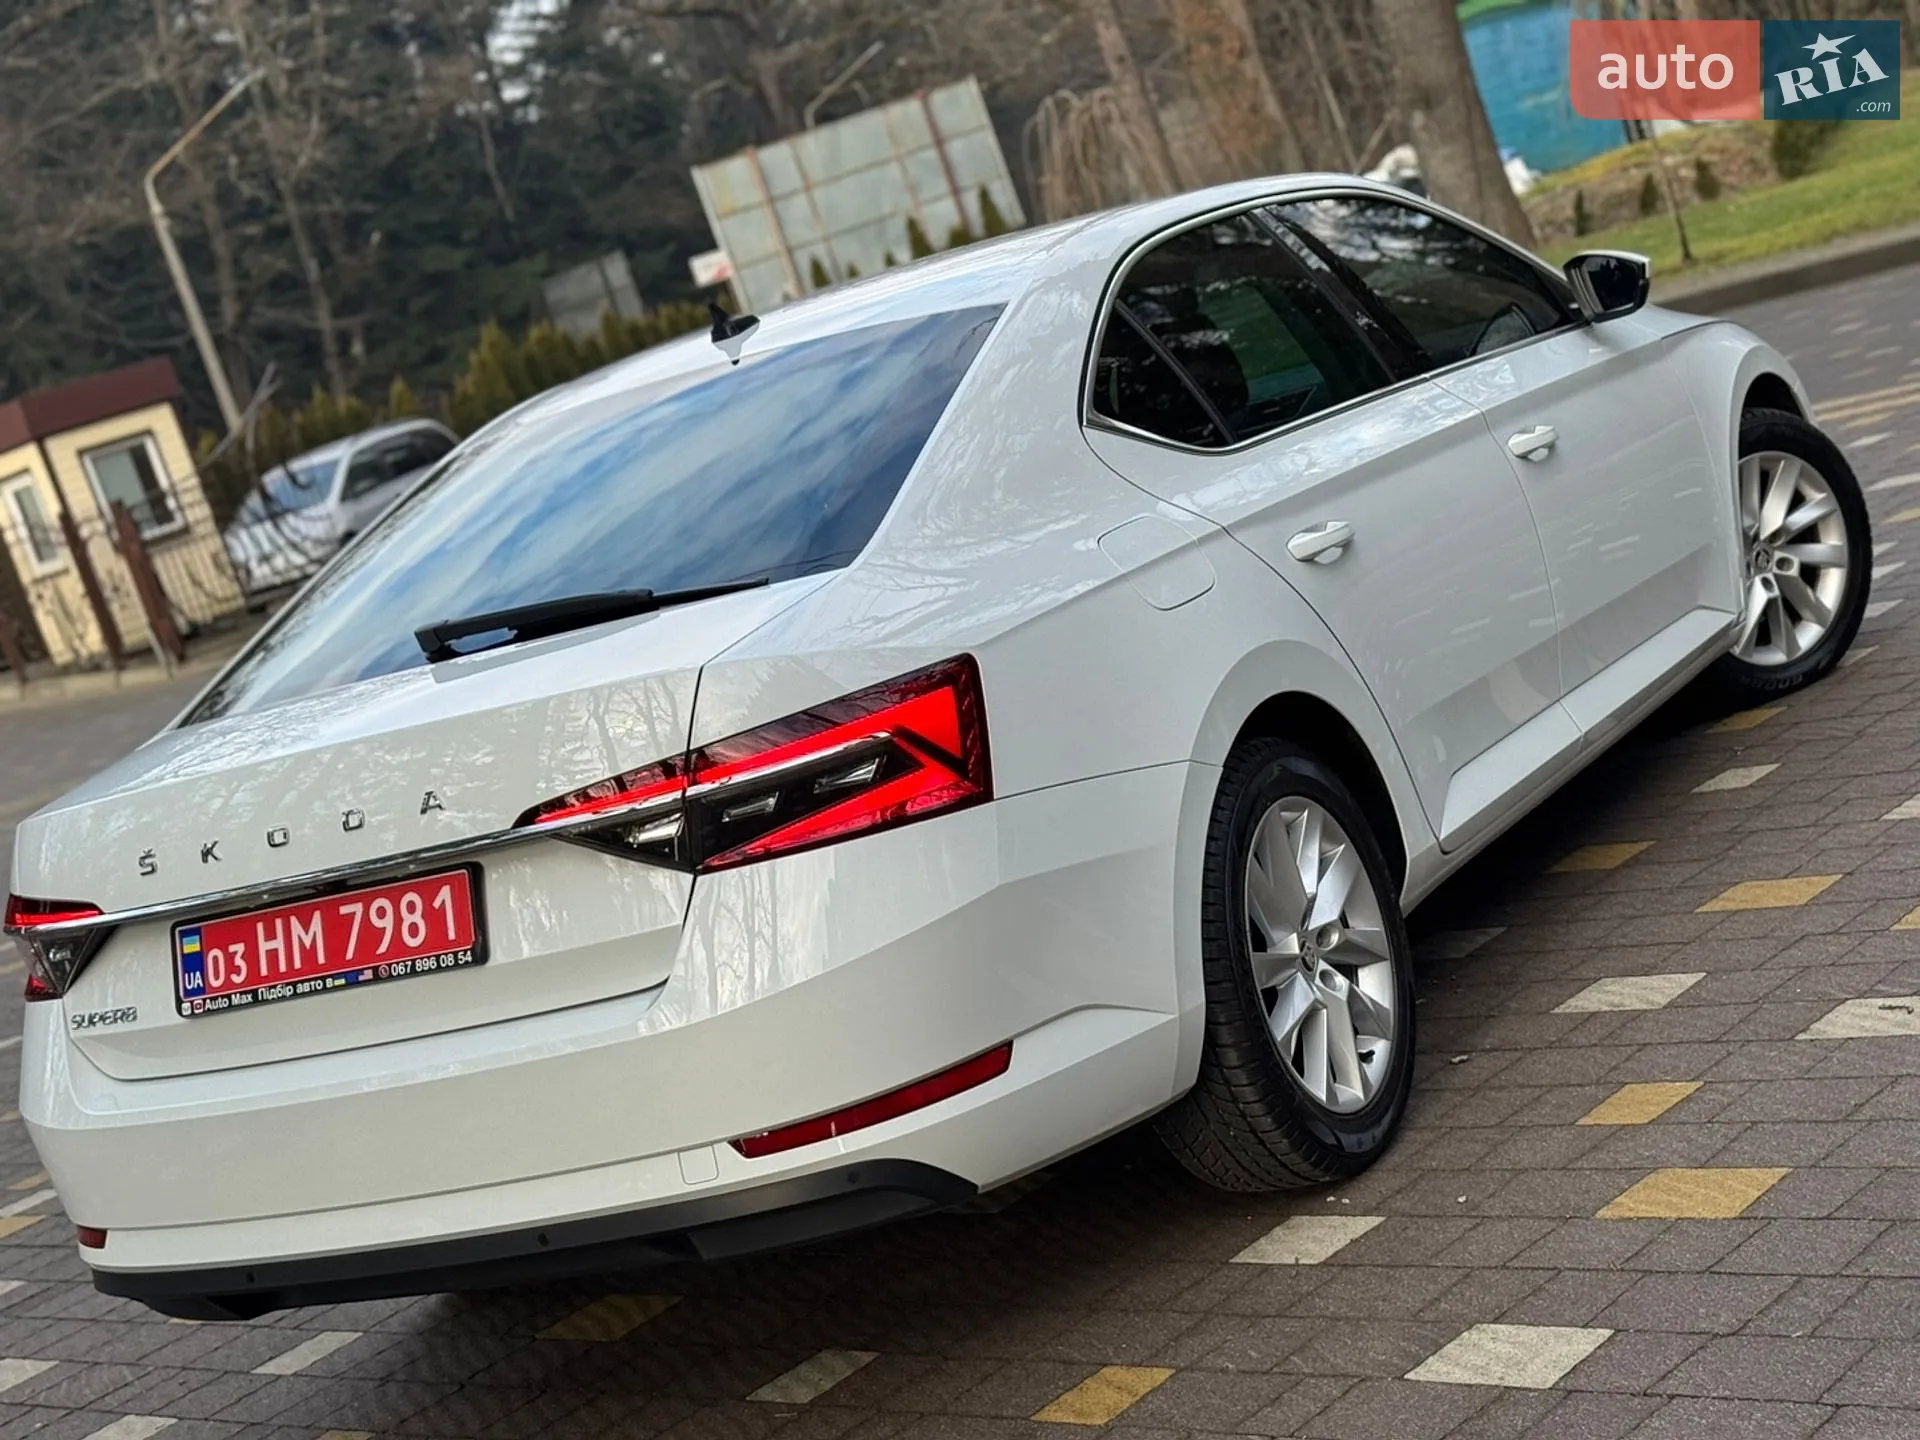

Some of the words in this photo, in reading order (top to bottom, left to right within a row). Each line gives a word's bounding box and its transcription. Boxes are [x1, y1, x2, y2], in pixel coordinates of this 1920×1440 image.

[138, 790, 445, 876] ŠKODA
[206, 942, 248, 989] 03
[256, 909, 326, 978] HM
[339, 884, 456, 961] 7981
[184, 970, 204, 990] UA
[204, 998, 229, 1012] Auto
[231, 992, 253, 1006] Max
[257, 985, 294, 1002] Підбір
[295, 979, 324, 994] авто
[390, 960, 412, 977] 067
[415, 956, 437, 972] 896
[439, 953, 455, 966] 08
[457, 949, 473, 964] 54
[71, 1006, 137, 1030] SUPERB
